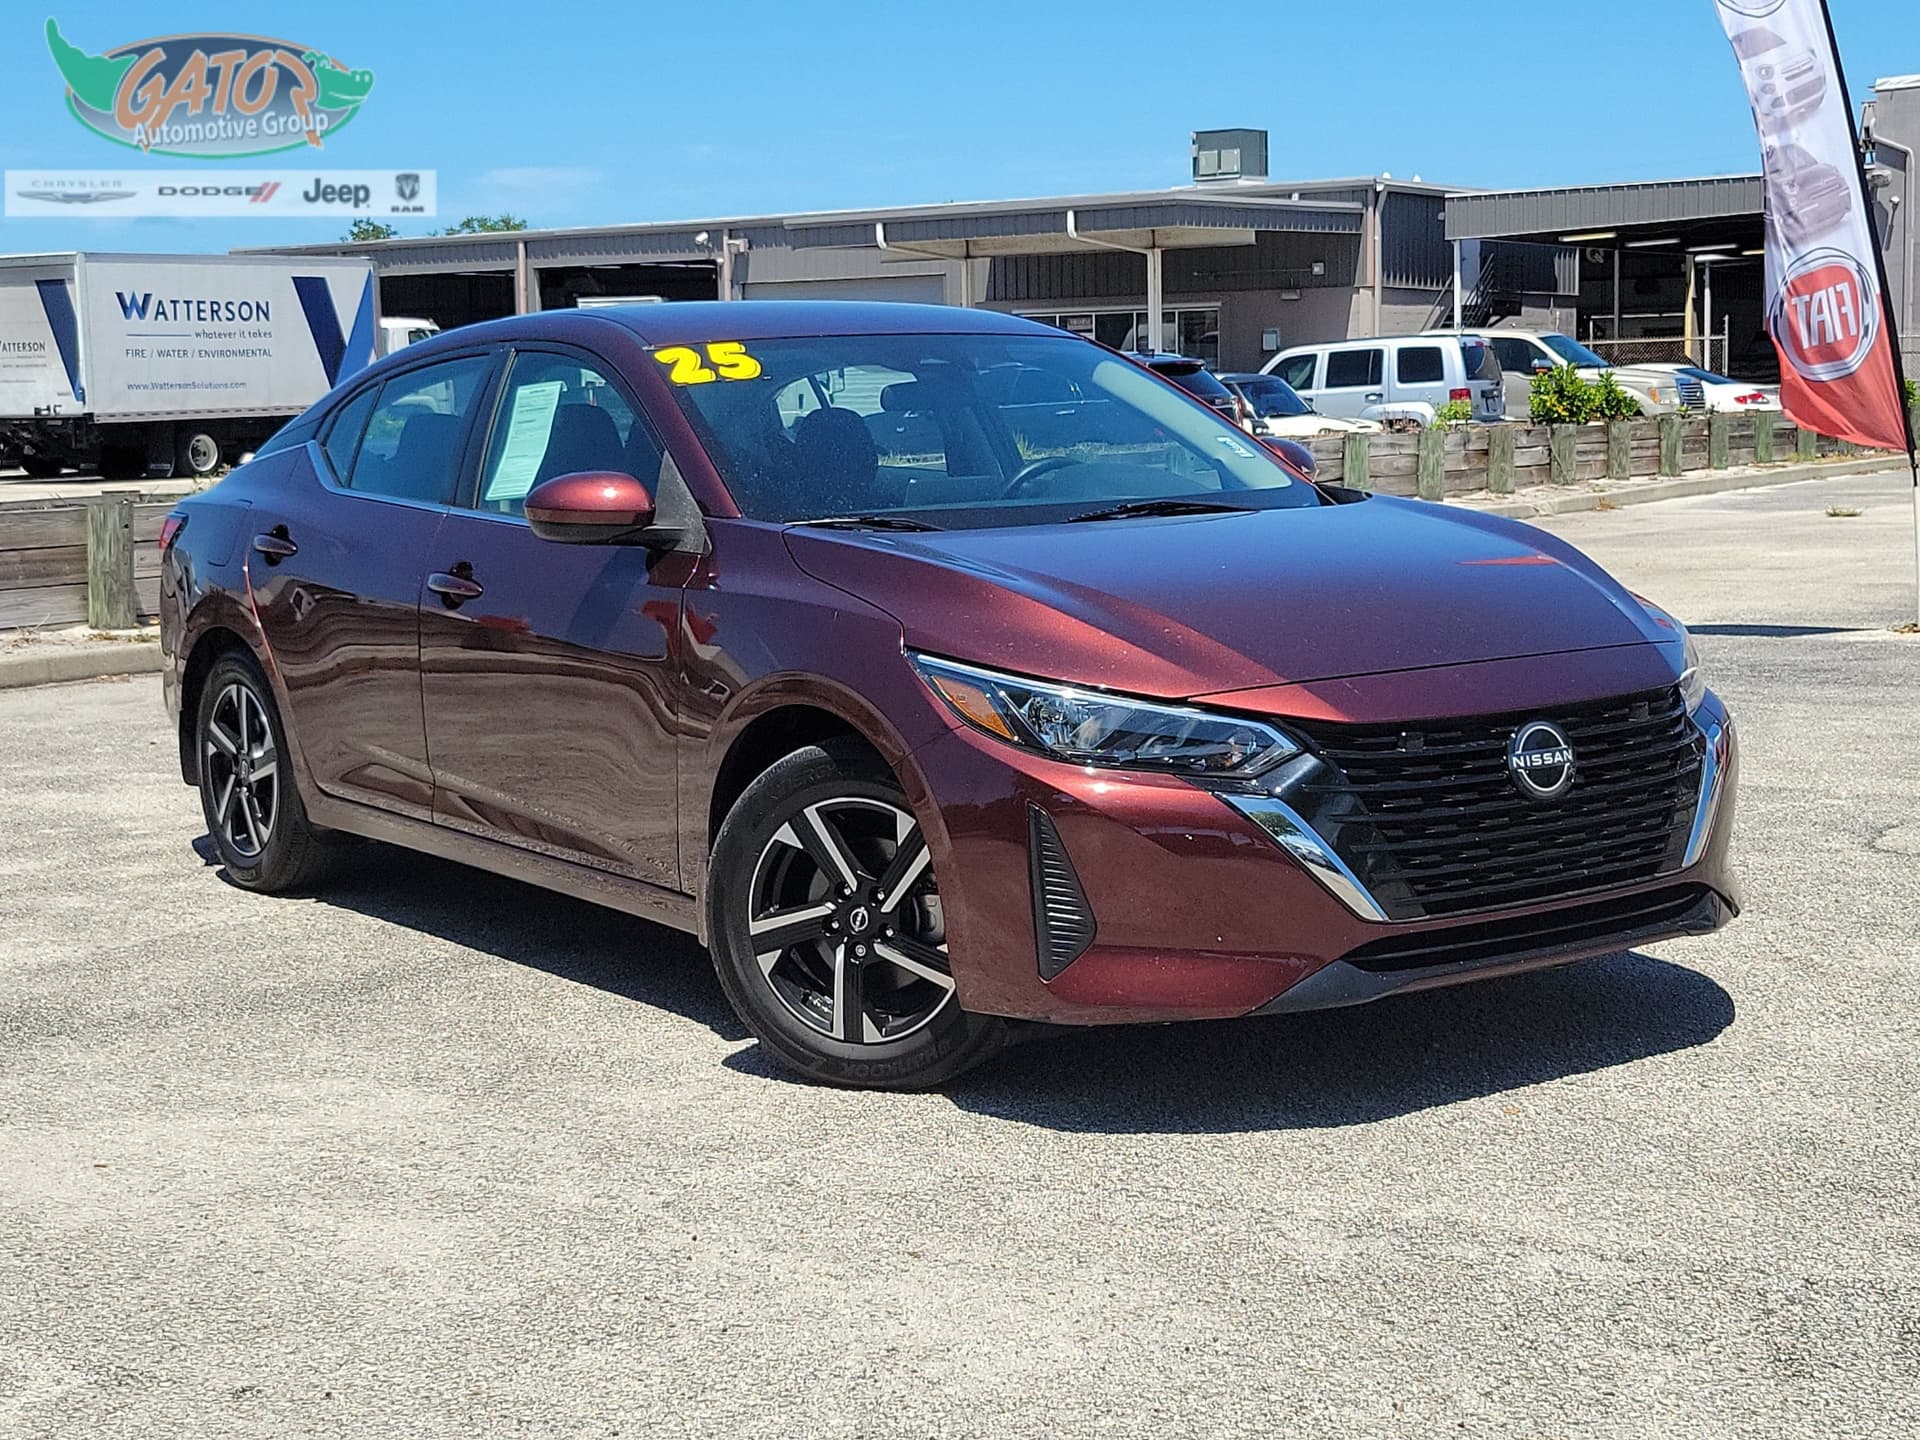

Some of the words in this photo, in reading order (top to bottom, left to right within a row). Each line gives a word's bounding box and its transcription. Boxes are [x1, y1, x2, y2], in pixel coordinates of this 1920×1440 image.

[115, 291, 271, 321] WATTERSON
[195, 328, 236, 340] whatever
[239, 328, 246, 339] it
[248, 329, 273, 339] takes
[0, 341, 46, 353] ATTERSON
[126, 349, 147, 359] FIRE
[157, 349, 188, 359] WATER
[198, 348, 273, 359] ENVIRONMENTAL
[654, 341, 763, 385] 25
[127, 381, 247, 391] www.WattersonSolutions.com
[1512, 749, 1573, 768] NISSAN
